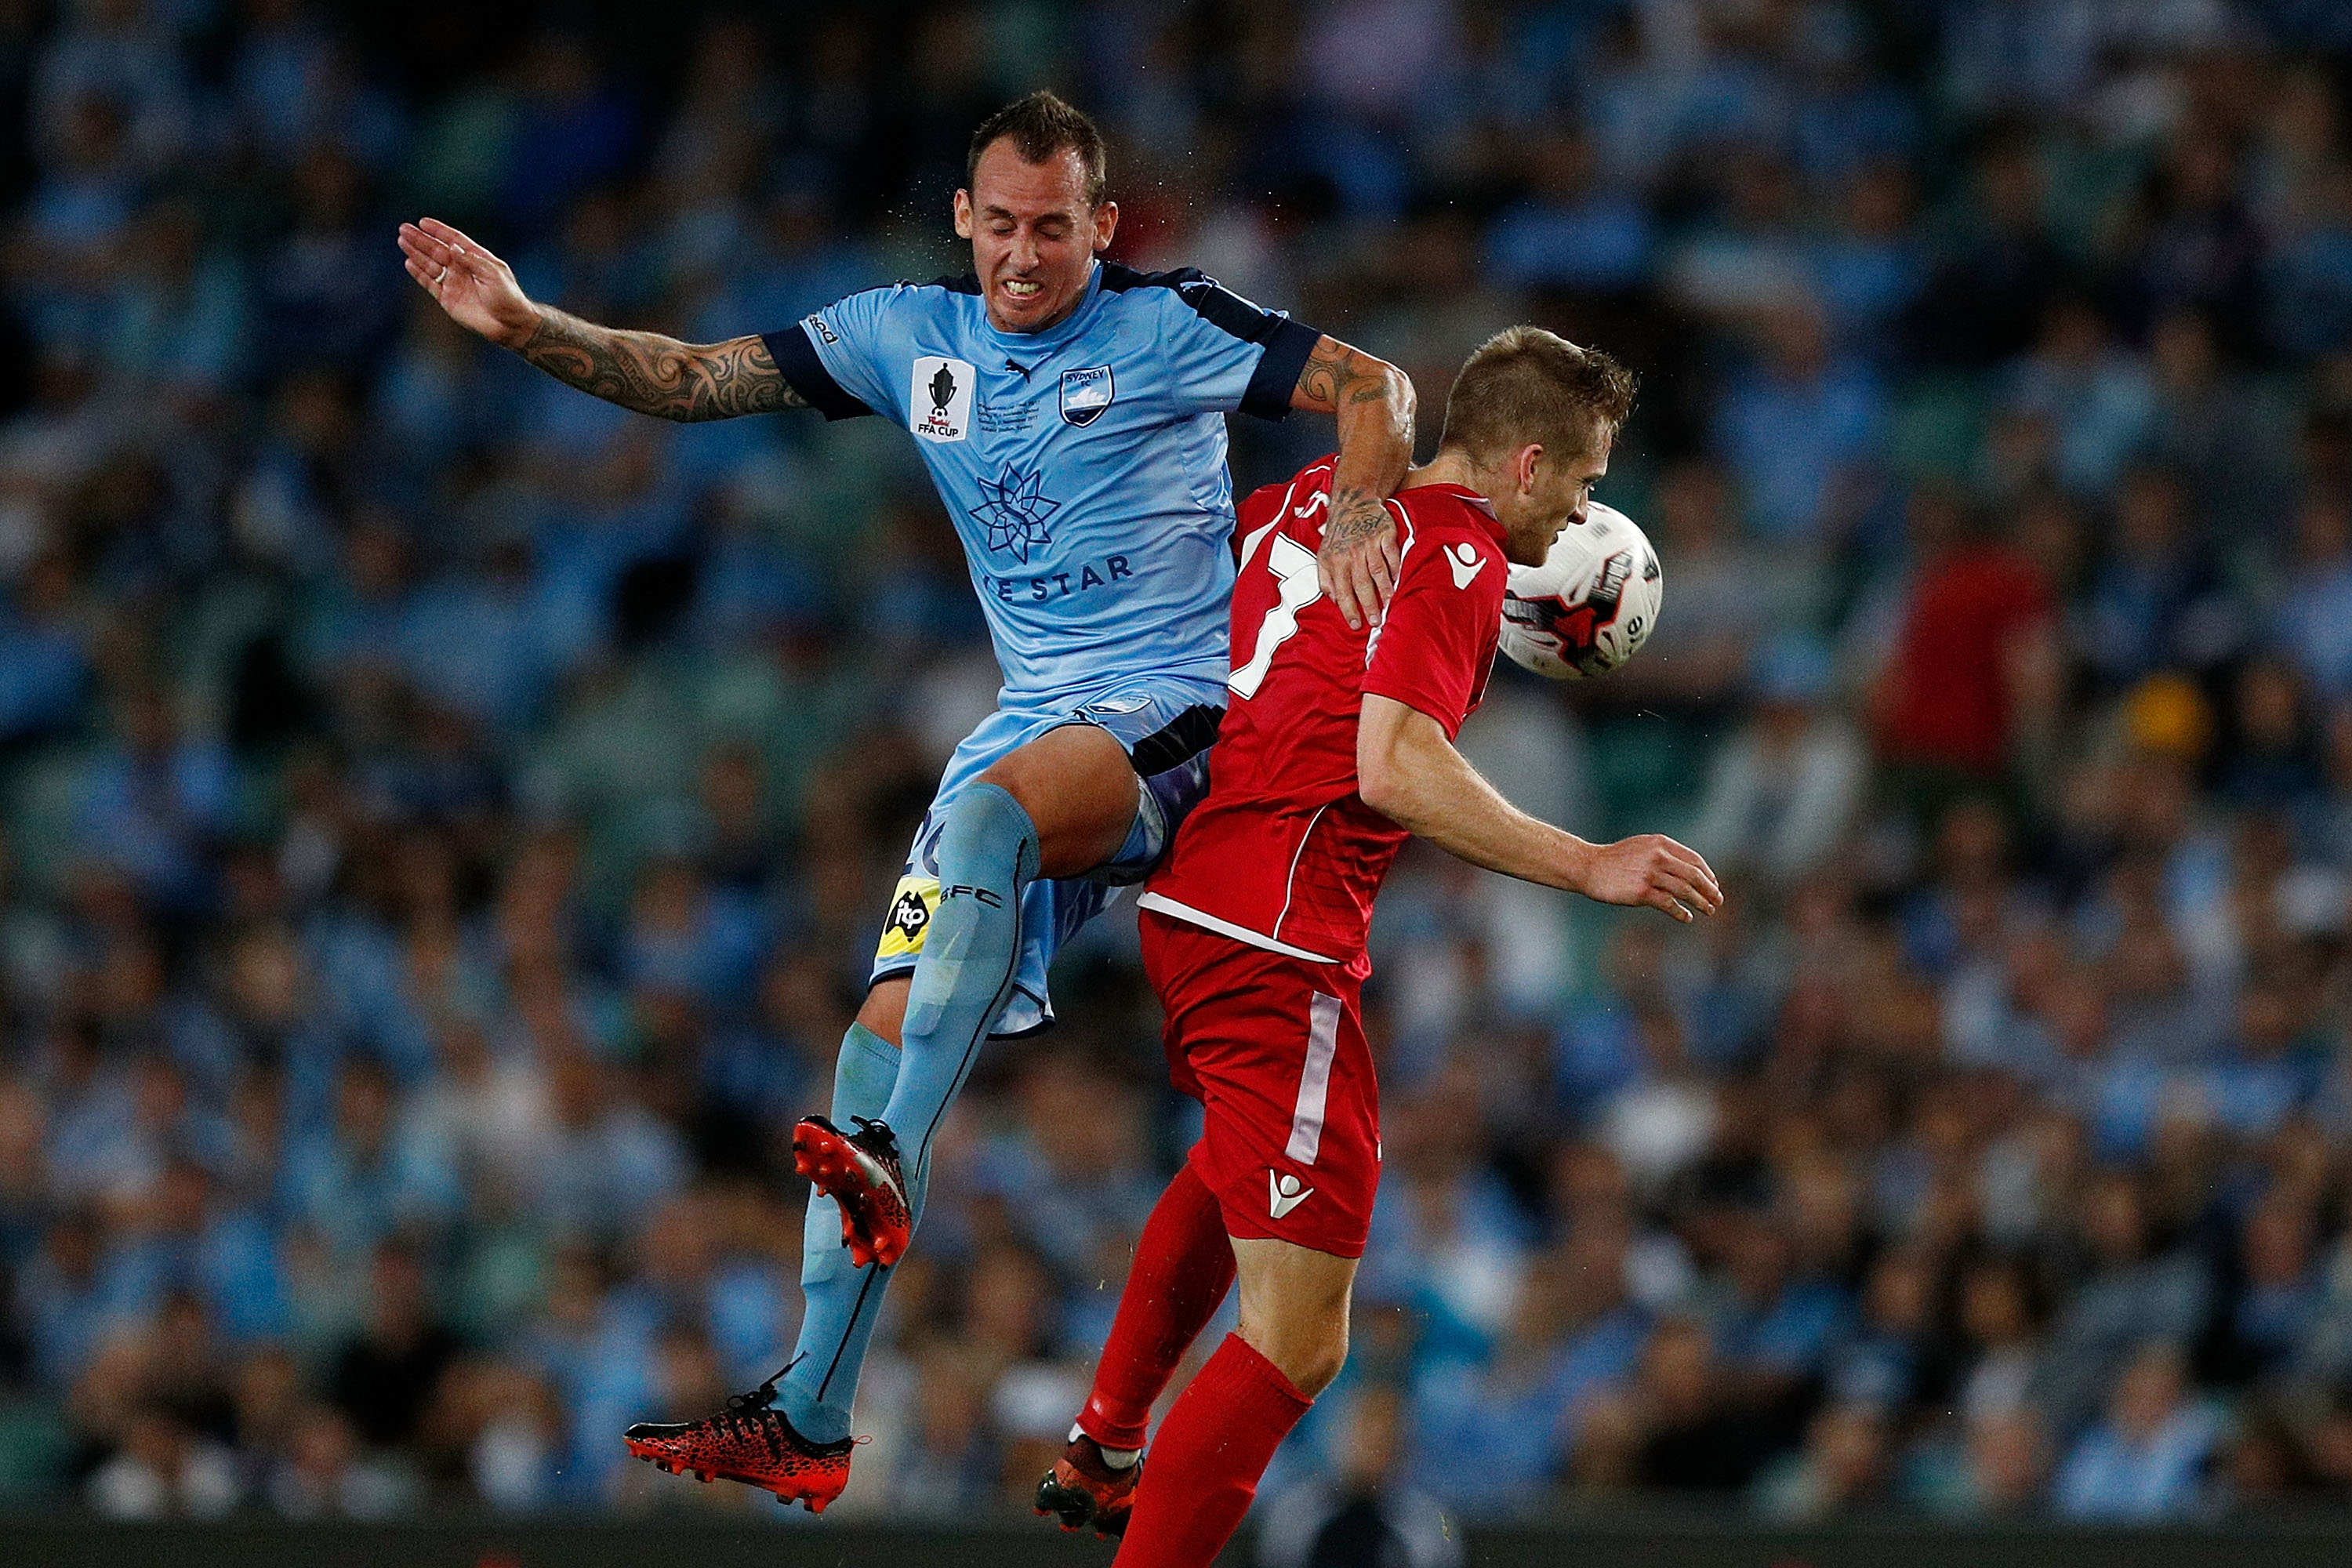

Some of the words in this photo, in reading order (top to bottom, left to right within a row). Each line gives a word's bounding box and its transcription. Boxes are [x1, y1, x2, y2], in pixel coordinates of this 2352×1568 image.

[1066, 370, 1104, 383] SYDNEY
[918, 423, 936, 434] FFA
[938, 426, 959, 437] CUP
[1029, 555, 1133, 601] STAR
